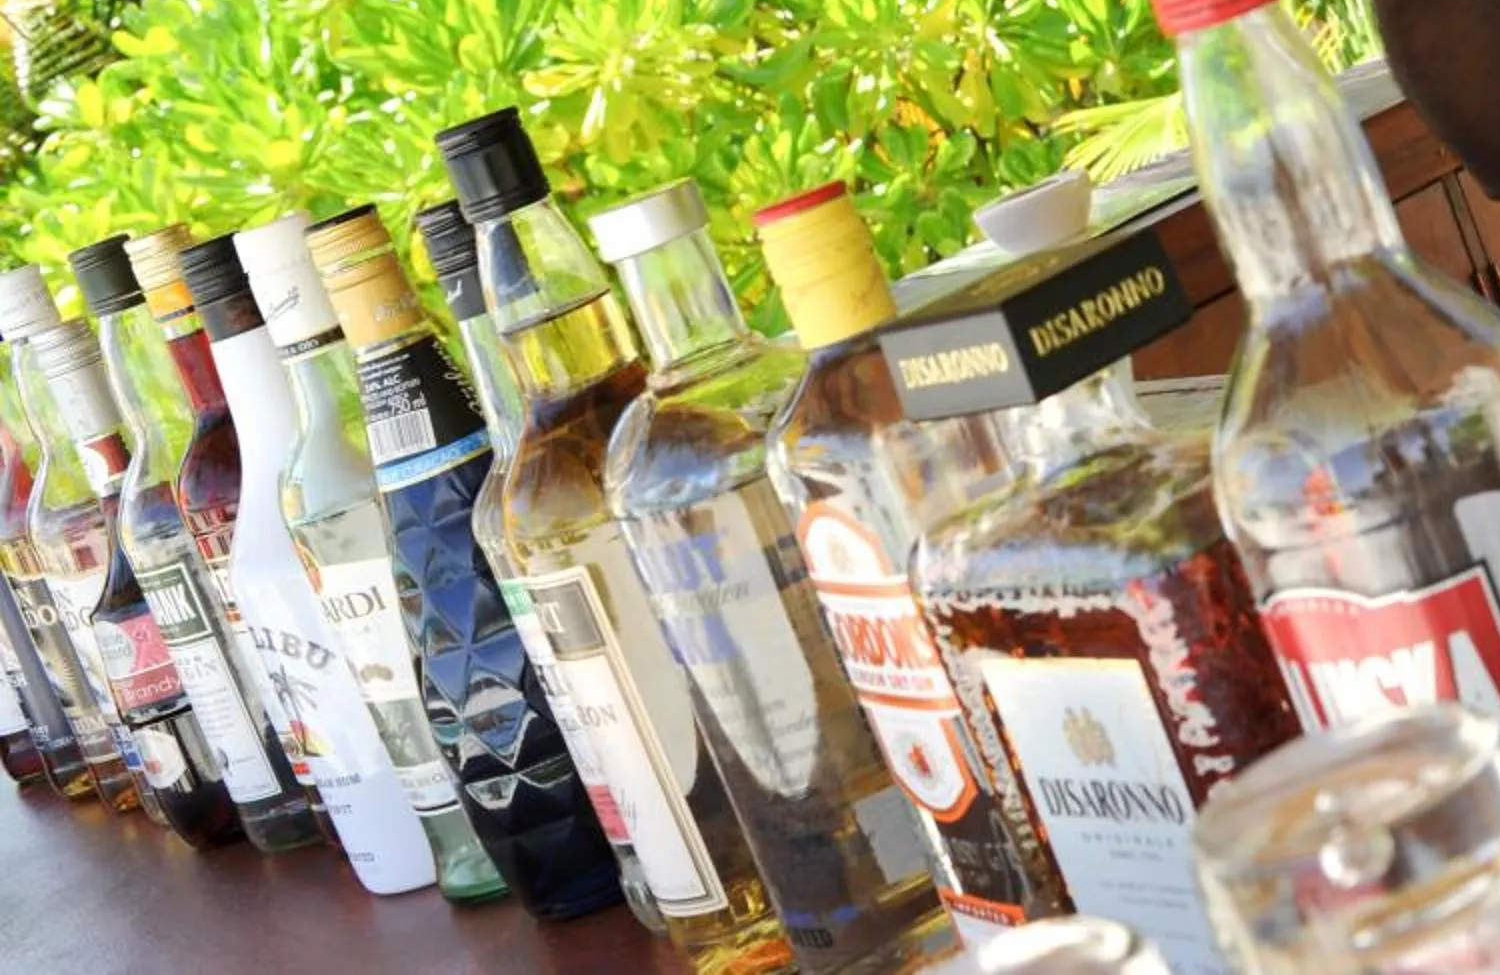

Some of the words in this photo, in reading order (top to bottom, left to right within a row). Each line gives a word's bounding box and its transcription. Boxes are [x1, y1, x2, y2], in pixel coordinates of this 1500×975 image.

[1028, 265, 1166, 357] DISARONNO
[898, 341, 1009, 389] DISARONNO
[1038, 777, 1186, 826] DISARONNO
